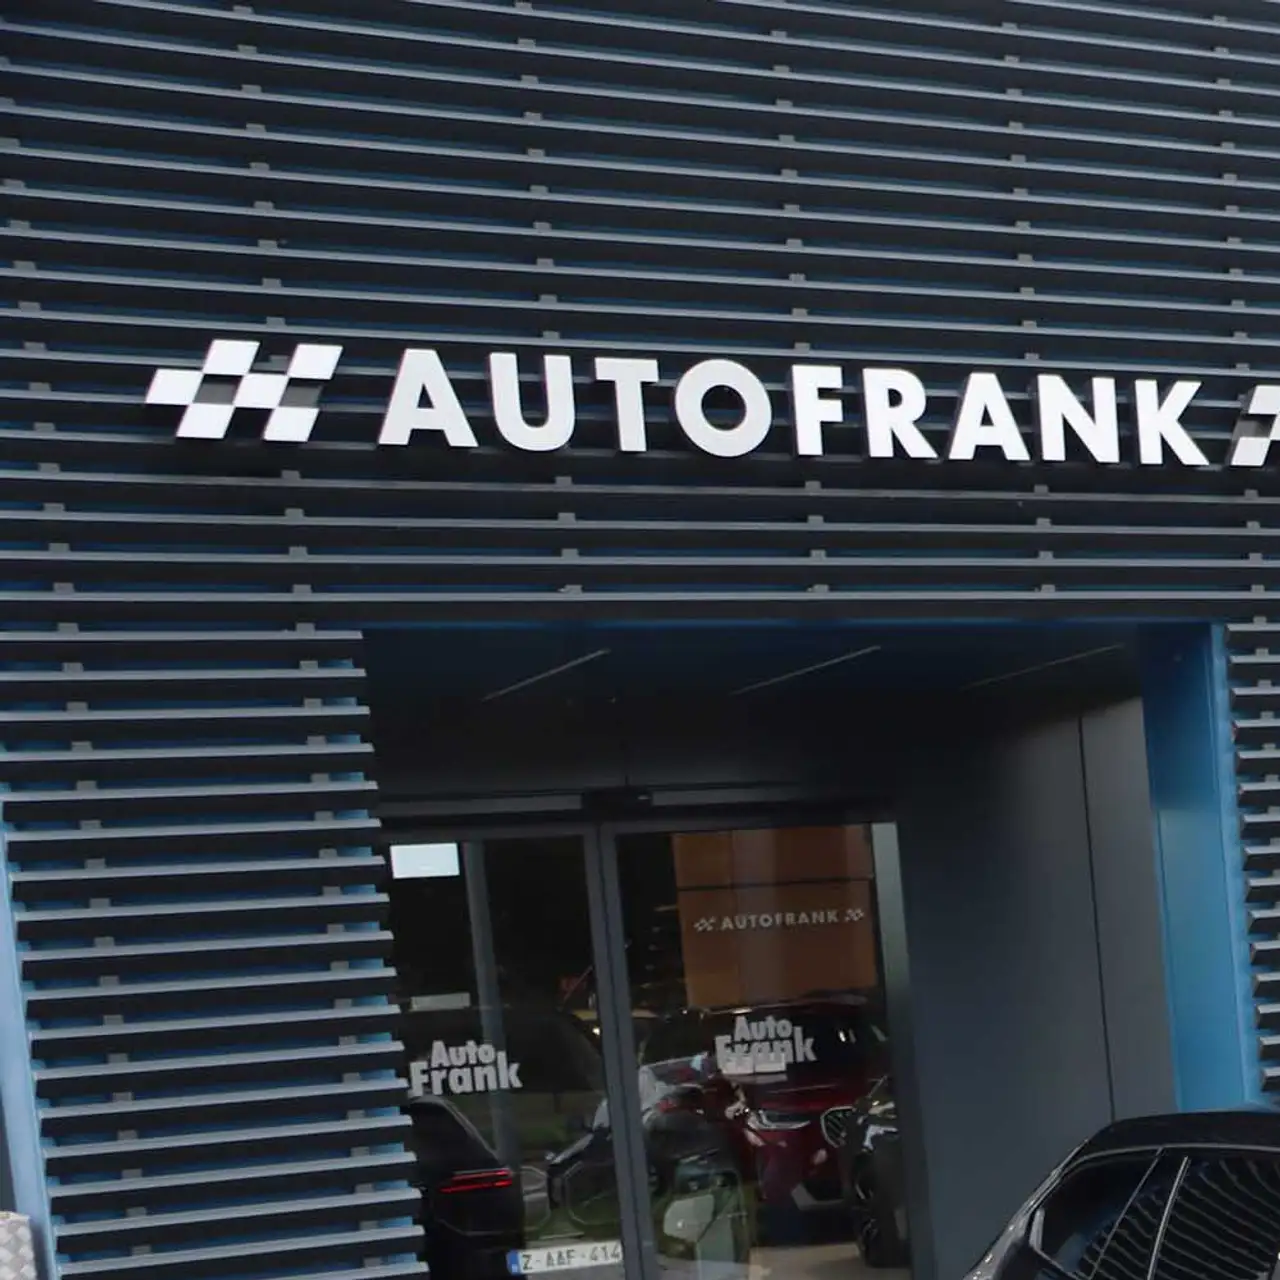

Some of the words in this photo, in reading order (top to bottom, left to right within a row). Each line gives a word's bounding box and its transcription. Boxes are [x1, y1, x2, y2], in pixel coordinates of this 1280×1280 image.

[378, 348, 1209, 466] AUTOFRANK
[720, 909, 839, 931] AUTOFRANK
[734, 1015, 793, 1042] Auto
[430, 1040, 495, 1068] Auto
[408, 1050, 523, 1097] Frank
